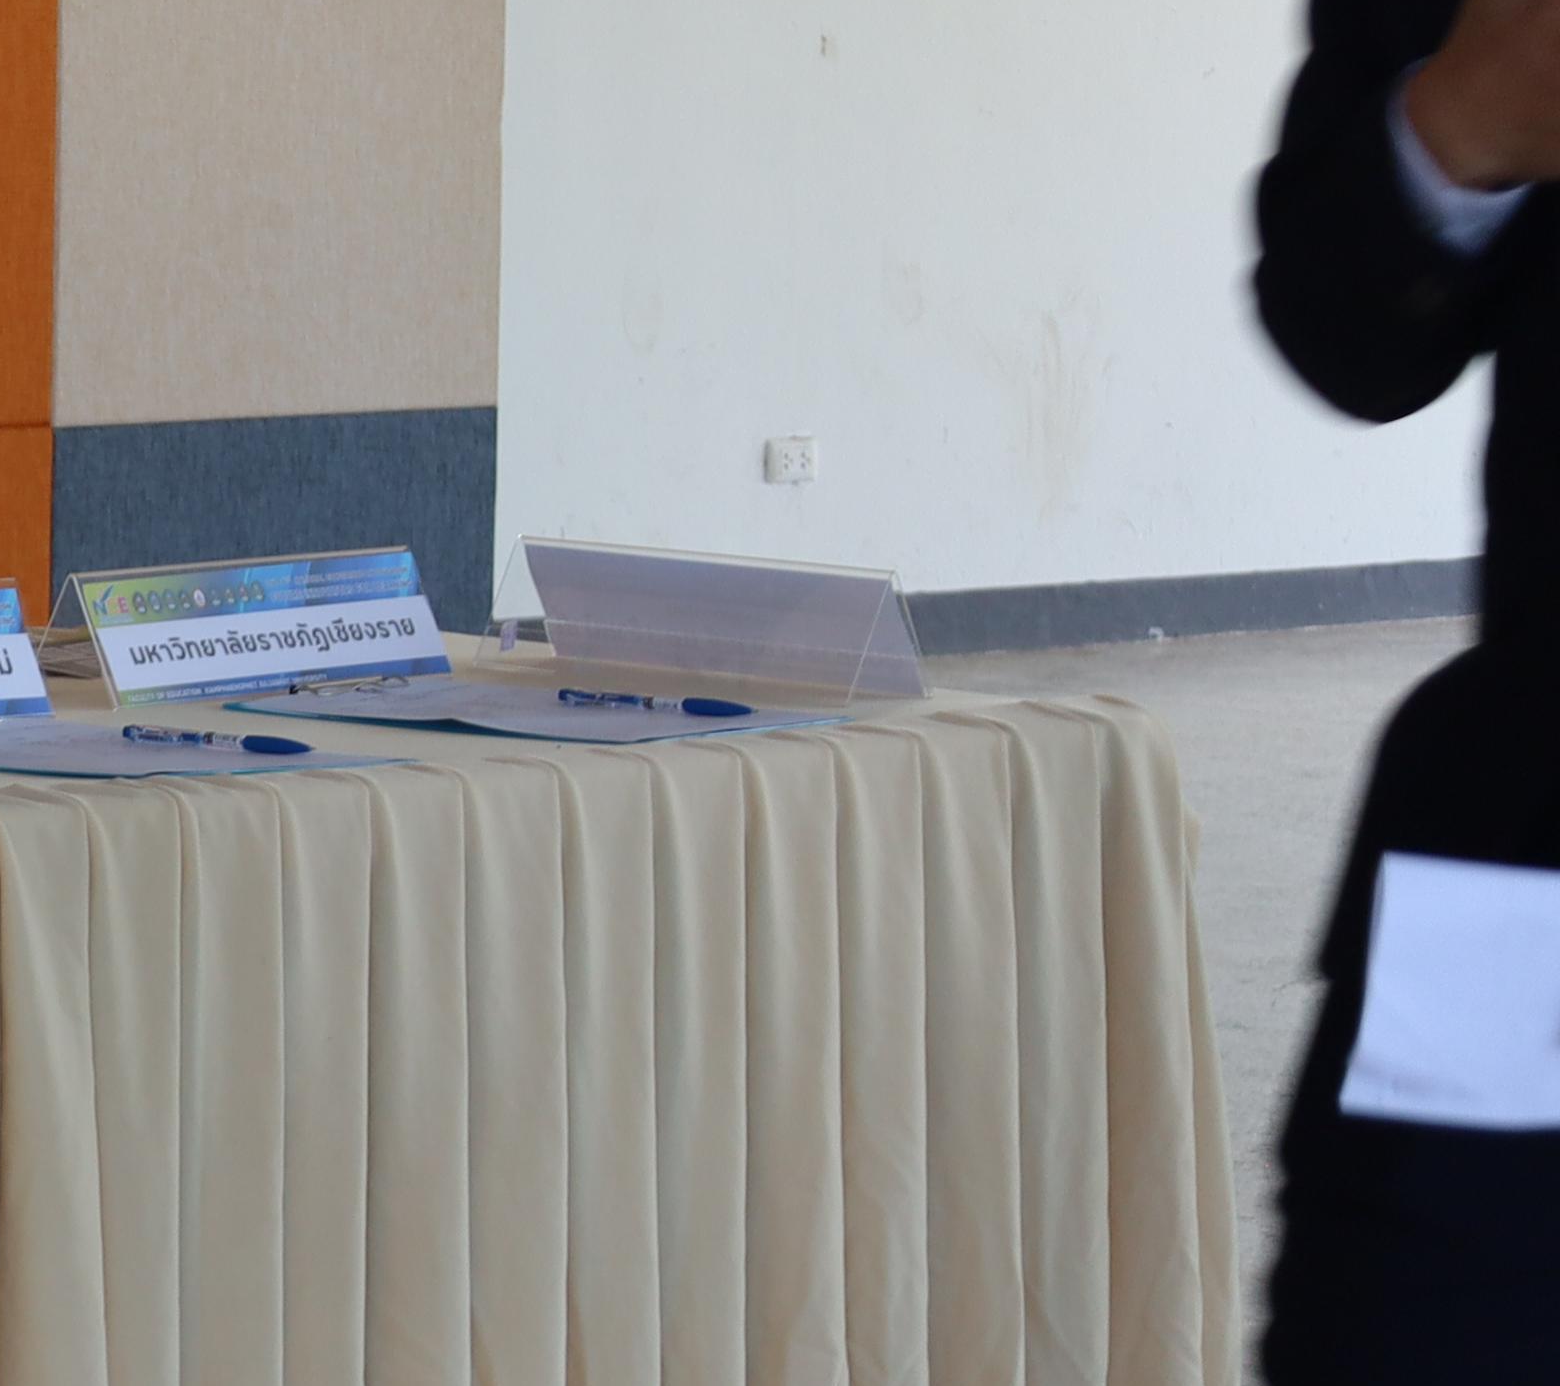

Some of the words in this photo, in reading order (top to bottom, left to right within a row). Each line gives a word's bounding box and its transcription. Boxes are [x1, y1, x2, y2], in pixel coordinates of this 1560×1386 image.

[128, 616, 416, 665] มหาวิทยาลัยราชภัฏเชียงราย
